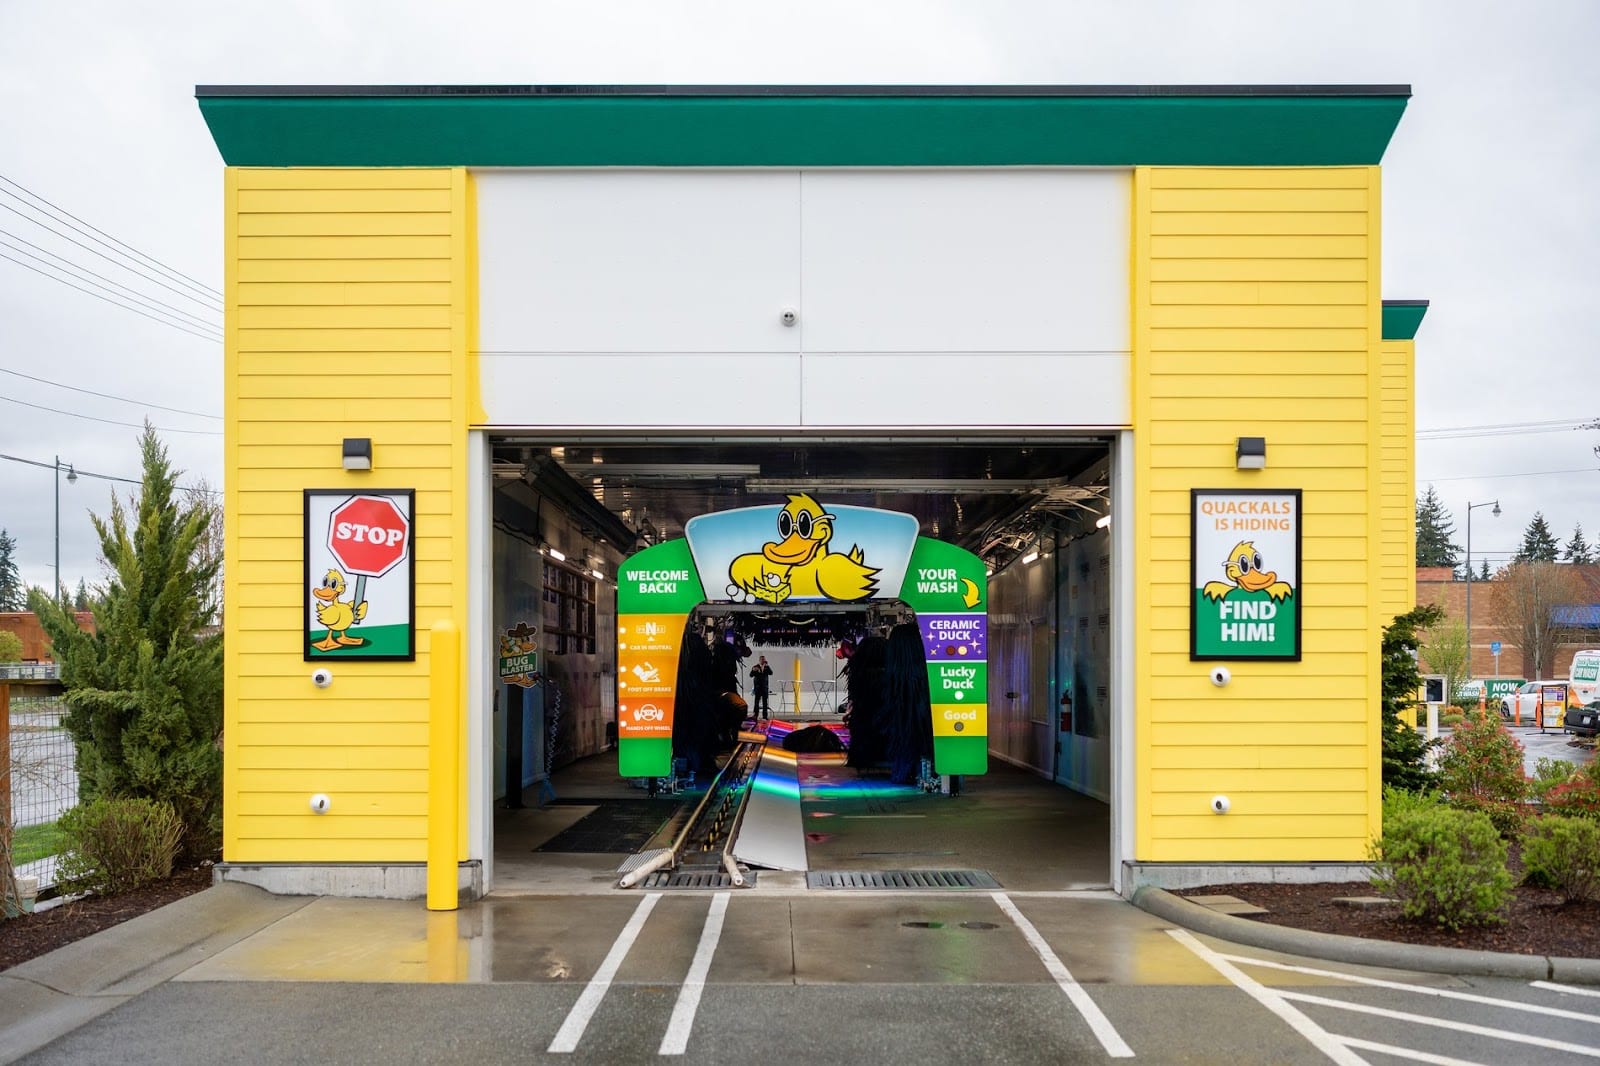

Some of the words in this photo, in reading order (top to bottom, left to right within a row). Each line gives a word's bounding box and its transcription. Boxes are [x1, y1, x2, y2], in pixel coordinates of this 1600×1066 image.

[1201, 501, 1291, 515] QUACKALS
[1215, 518, 1229, 531] IS
[1233, 518, 1291, 531] HIDING
[336, 521, 404, 547] STOP
[626, 570, 689, 581] WELCOME
[918, 568, 957, 580] YOUR
[639, 582, 677, 593] BACK!
[917, 581, 958, 593] WASH
[1219, 600, 1277, 620] FIND
[929, 620, 981, 630] CERAMIC
[938, 630, 971, 641] DUCK
[1221, 622, 1275, 642] HIM!
[506, 655, 529, 667] BUG
[501, 663, 534, 675] BLASTER
[940, 666, 977, 680] Lucky
[943, 678, 975, 689] Duck
[1492, 682, 1519, 692] NOW
[943, 709, 977, 721] Good
